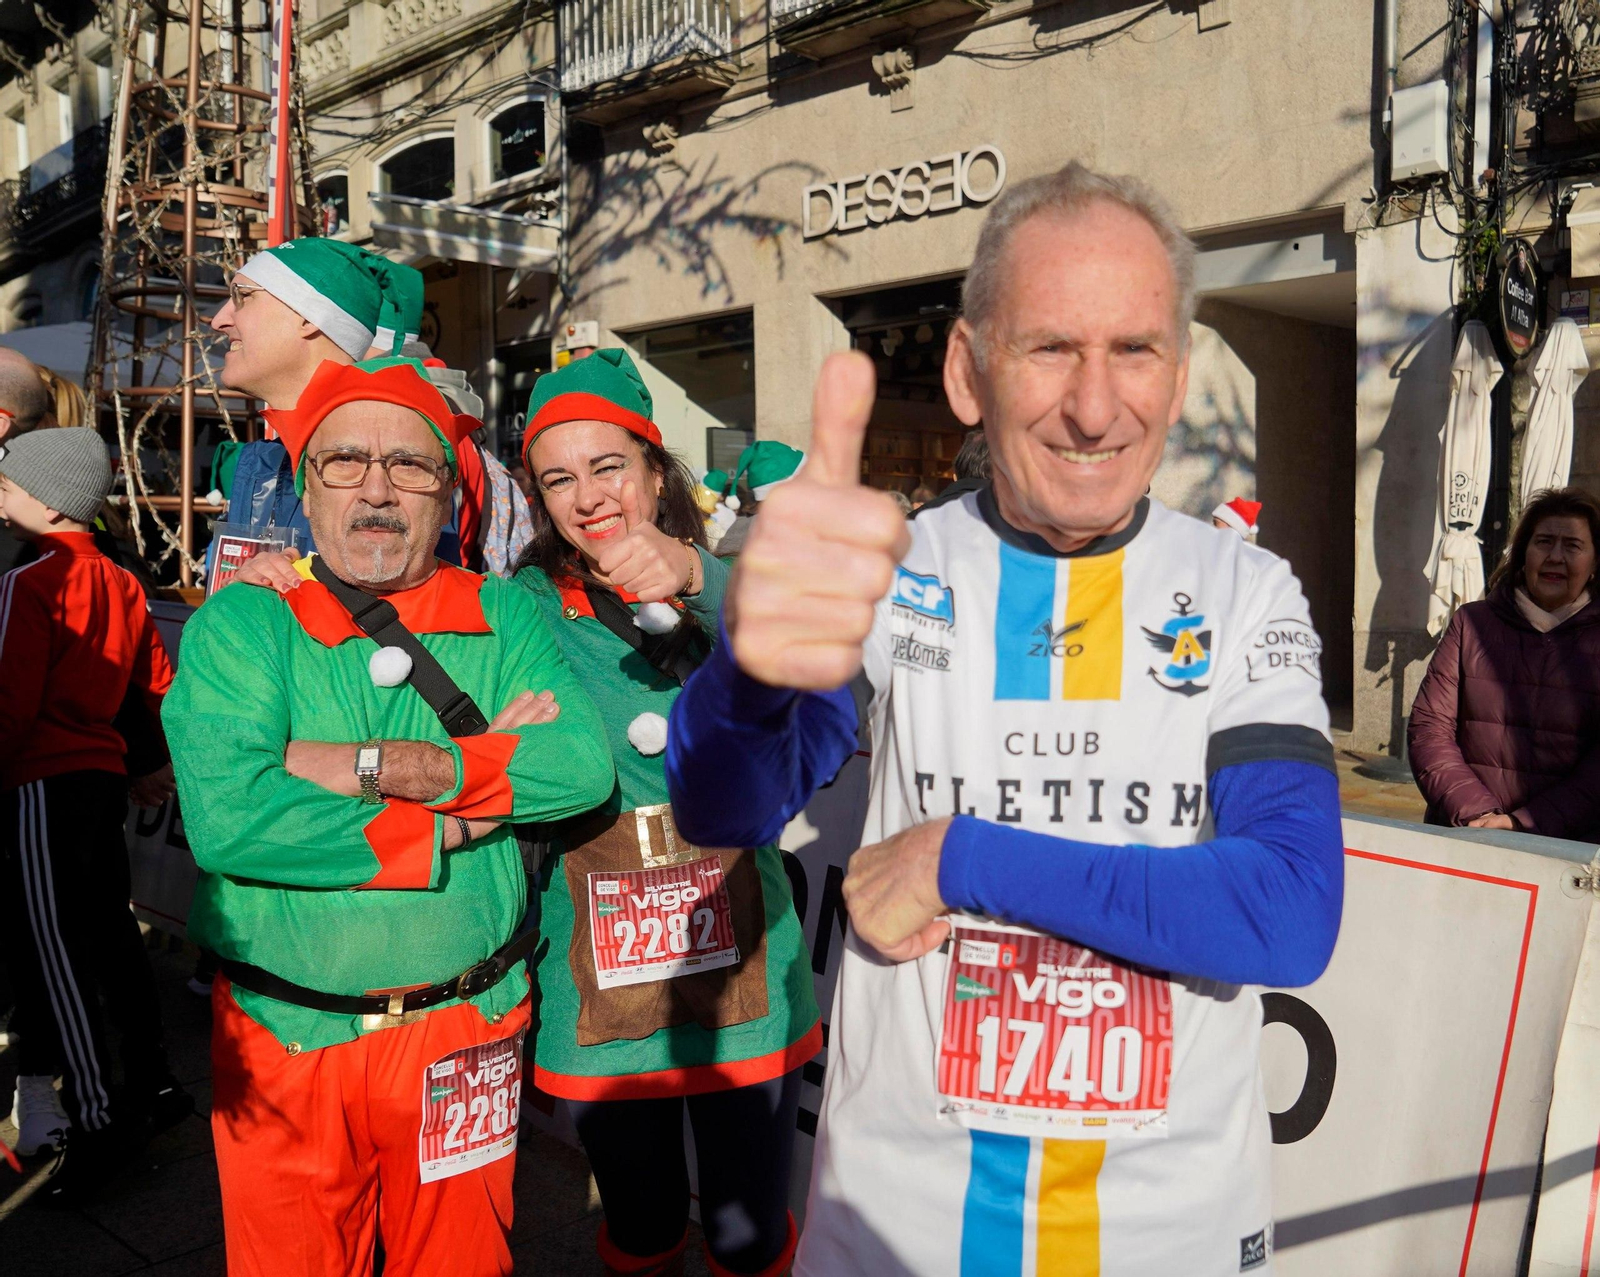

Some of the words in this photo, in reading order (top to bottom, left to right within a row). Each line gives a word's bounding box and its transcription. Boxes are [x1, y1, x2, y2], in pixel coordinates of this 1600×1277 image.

[802, 145, 1006, 238] DESSEO
[1507, 278, 1525, 301] Coffee
[1525, 287, 1534, 306] Bar
[1517, 307, 1529, 328] Alba
[1268, 651, 1292, 668] DE
[1004, 731, 1100, 757] CLUB
[630, 886, 701, 912] vigo
[644, 880, 692, 893] SILVESTRE
[613, 907, 719, 963] 2282
[1037, 963, 1111, 979] SILVESTRE
[1012, 972, 1127, 1018] vigo
[464, 1057, 517, 1088] vigo
[976, 1015, 1144, 1103] 1740
